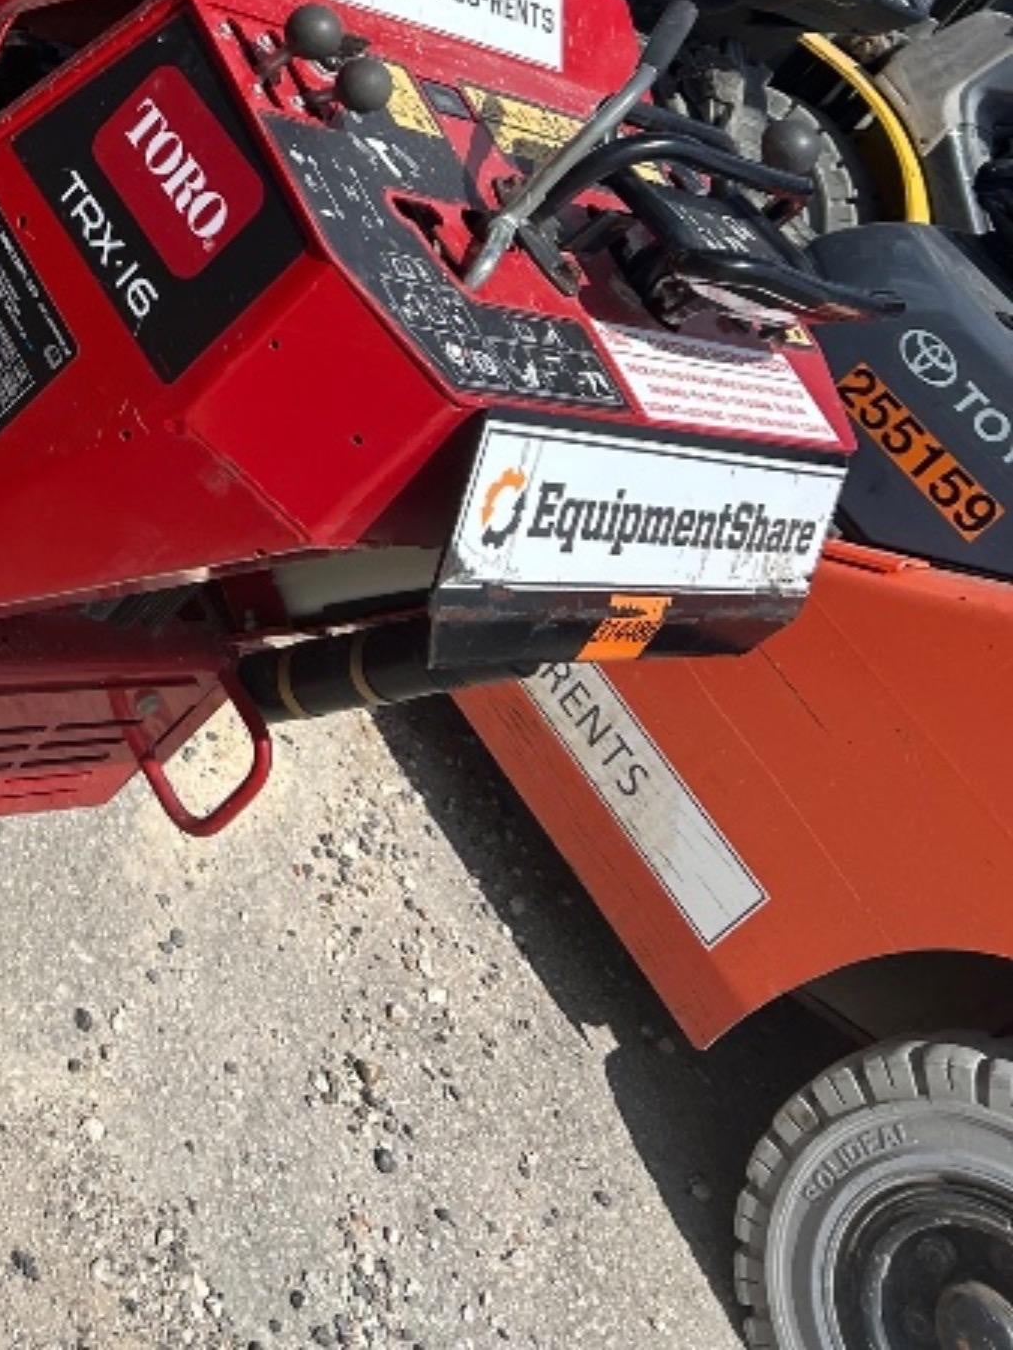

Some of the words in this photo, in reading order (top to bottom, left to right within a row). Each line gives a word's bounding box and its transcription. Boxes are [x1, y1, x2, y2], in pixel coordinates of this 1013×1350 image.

[124, 96, 229, 240] TORO
[838, 367, 997, 533] 255159
[953, 380, 1013, 463] TO
[527, 481, 816, 556] EquipmentShare
